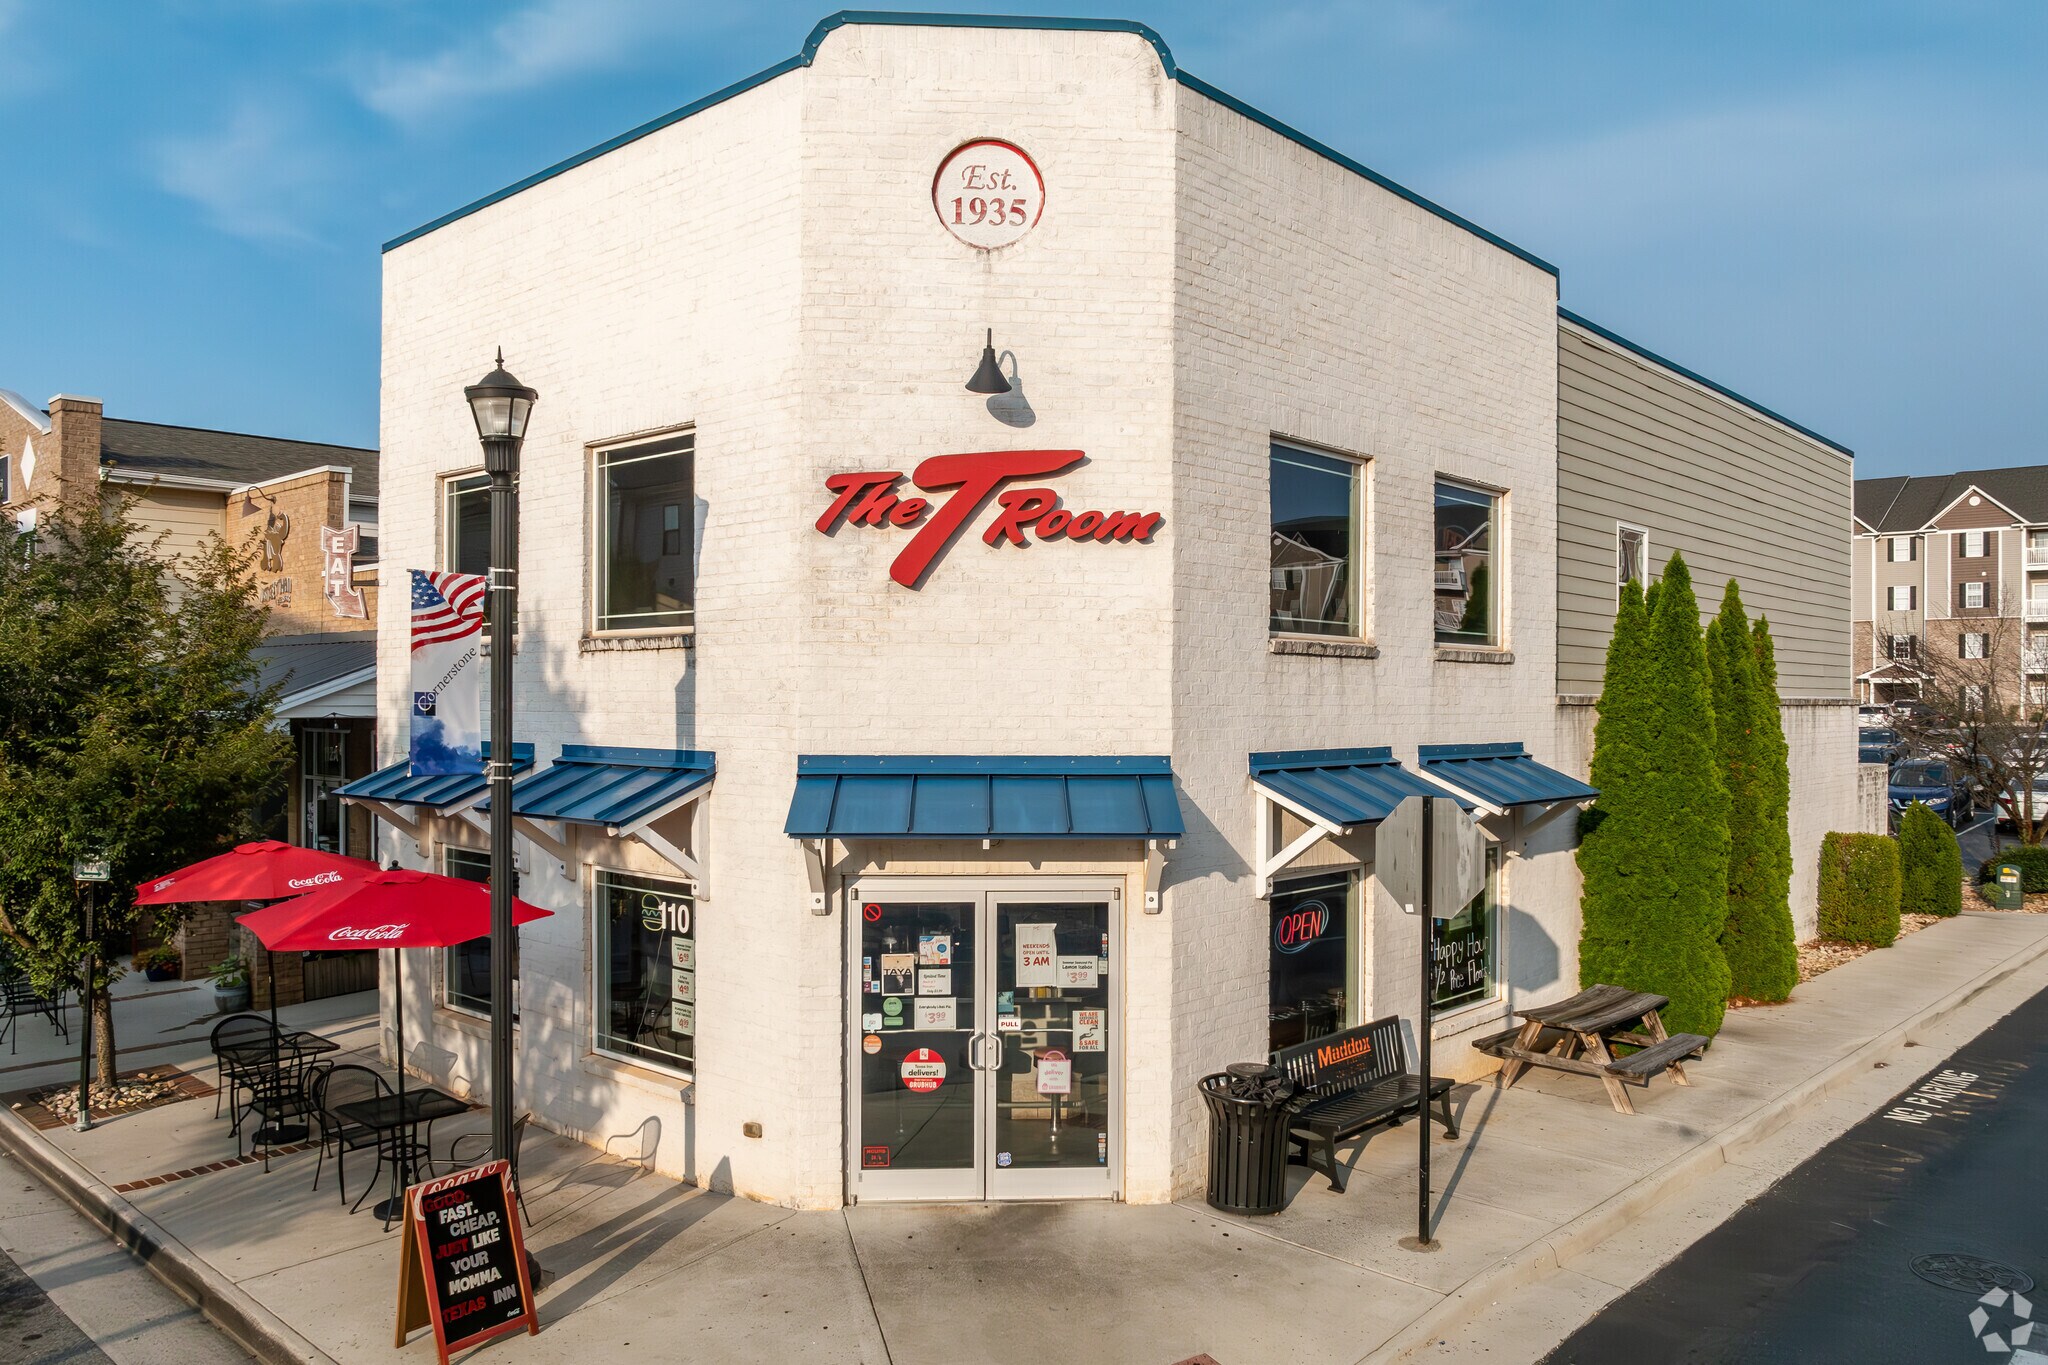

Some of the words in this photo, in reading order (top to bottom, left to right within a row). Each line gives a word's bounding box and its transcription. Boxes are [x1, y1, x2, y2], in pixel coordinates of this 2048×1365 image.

[962, 165, 1017, 191] Est.
[951, 196, 1027, 227] 1935
[814, 471, 927, 533] The
[982, 488, 1162, 545] Room
[889, 449, 1086, 588] T
[331, 536, 345, 597] EAT
[417, 647, 477, 712] Cornerstone
[328, 922, 411, 941] Coca-Cola
[659, 902, 690, 934] 110
[1280, 911, 1321, 944] OPEN
[1023, 956, 1031, 967] 3
[1032, 956, 1050, 966] AM
[1433, 937, 1464, 968] Happy
[1467, 932, 1488, 957] Hour
[1435, 963, 1446, 993] 1/2
[1450, 969, 1465, 990] Price
[1317, 1037, 1371, 1069] Maddox
[1904, 1069, 1979, 1108] PARKING
[1883, 1107, 1932, 1124] NO
[439, 1201, 479, 1225] FAST.
[450, 1210, 500, 1237] CHEAP.
[436, 1237, 468, 1260] JUST
[471, 1228, 500, 1250] LIKE
[450, 1250, 489, 1275] YOUR
[448, 1266, 502, 1296] MOMMA
[442, 1296, 487, 1323] TEXAS
[492, 1283, 517, 1305] INN
